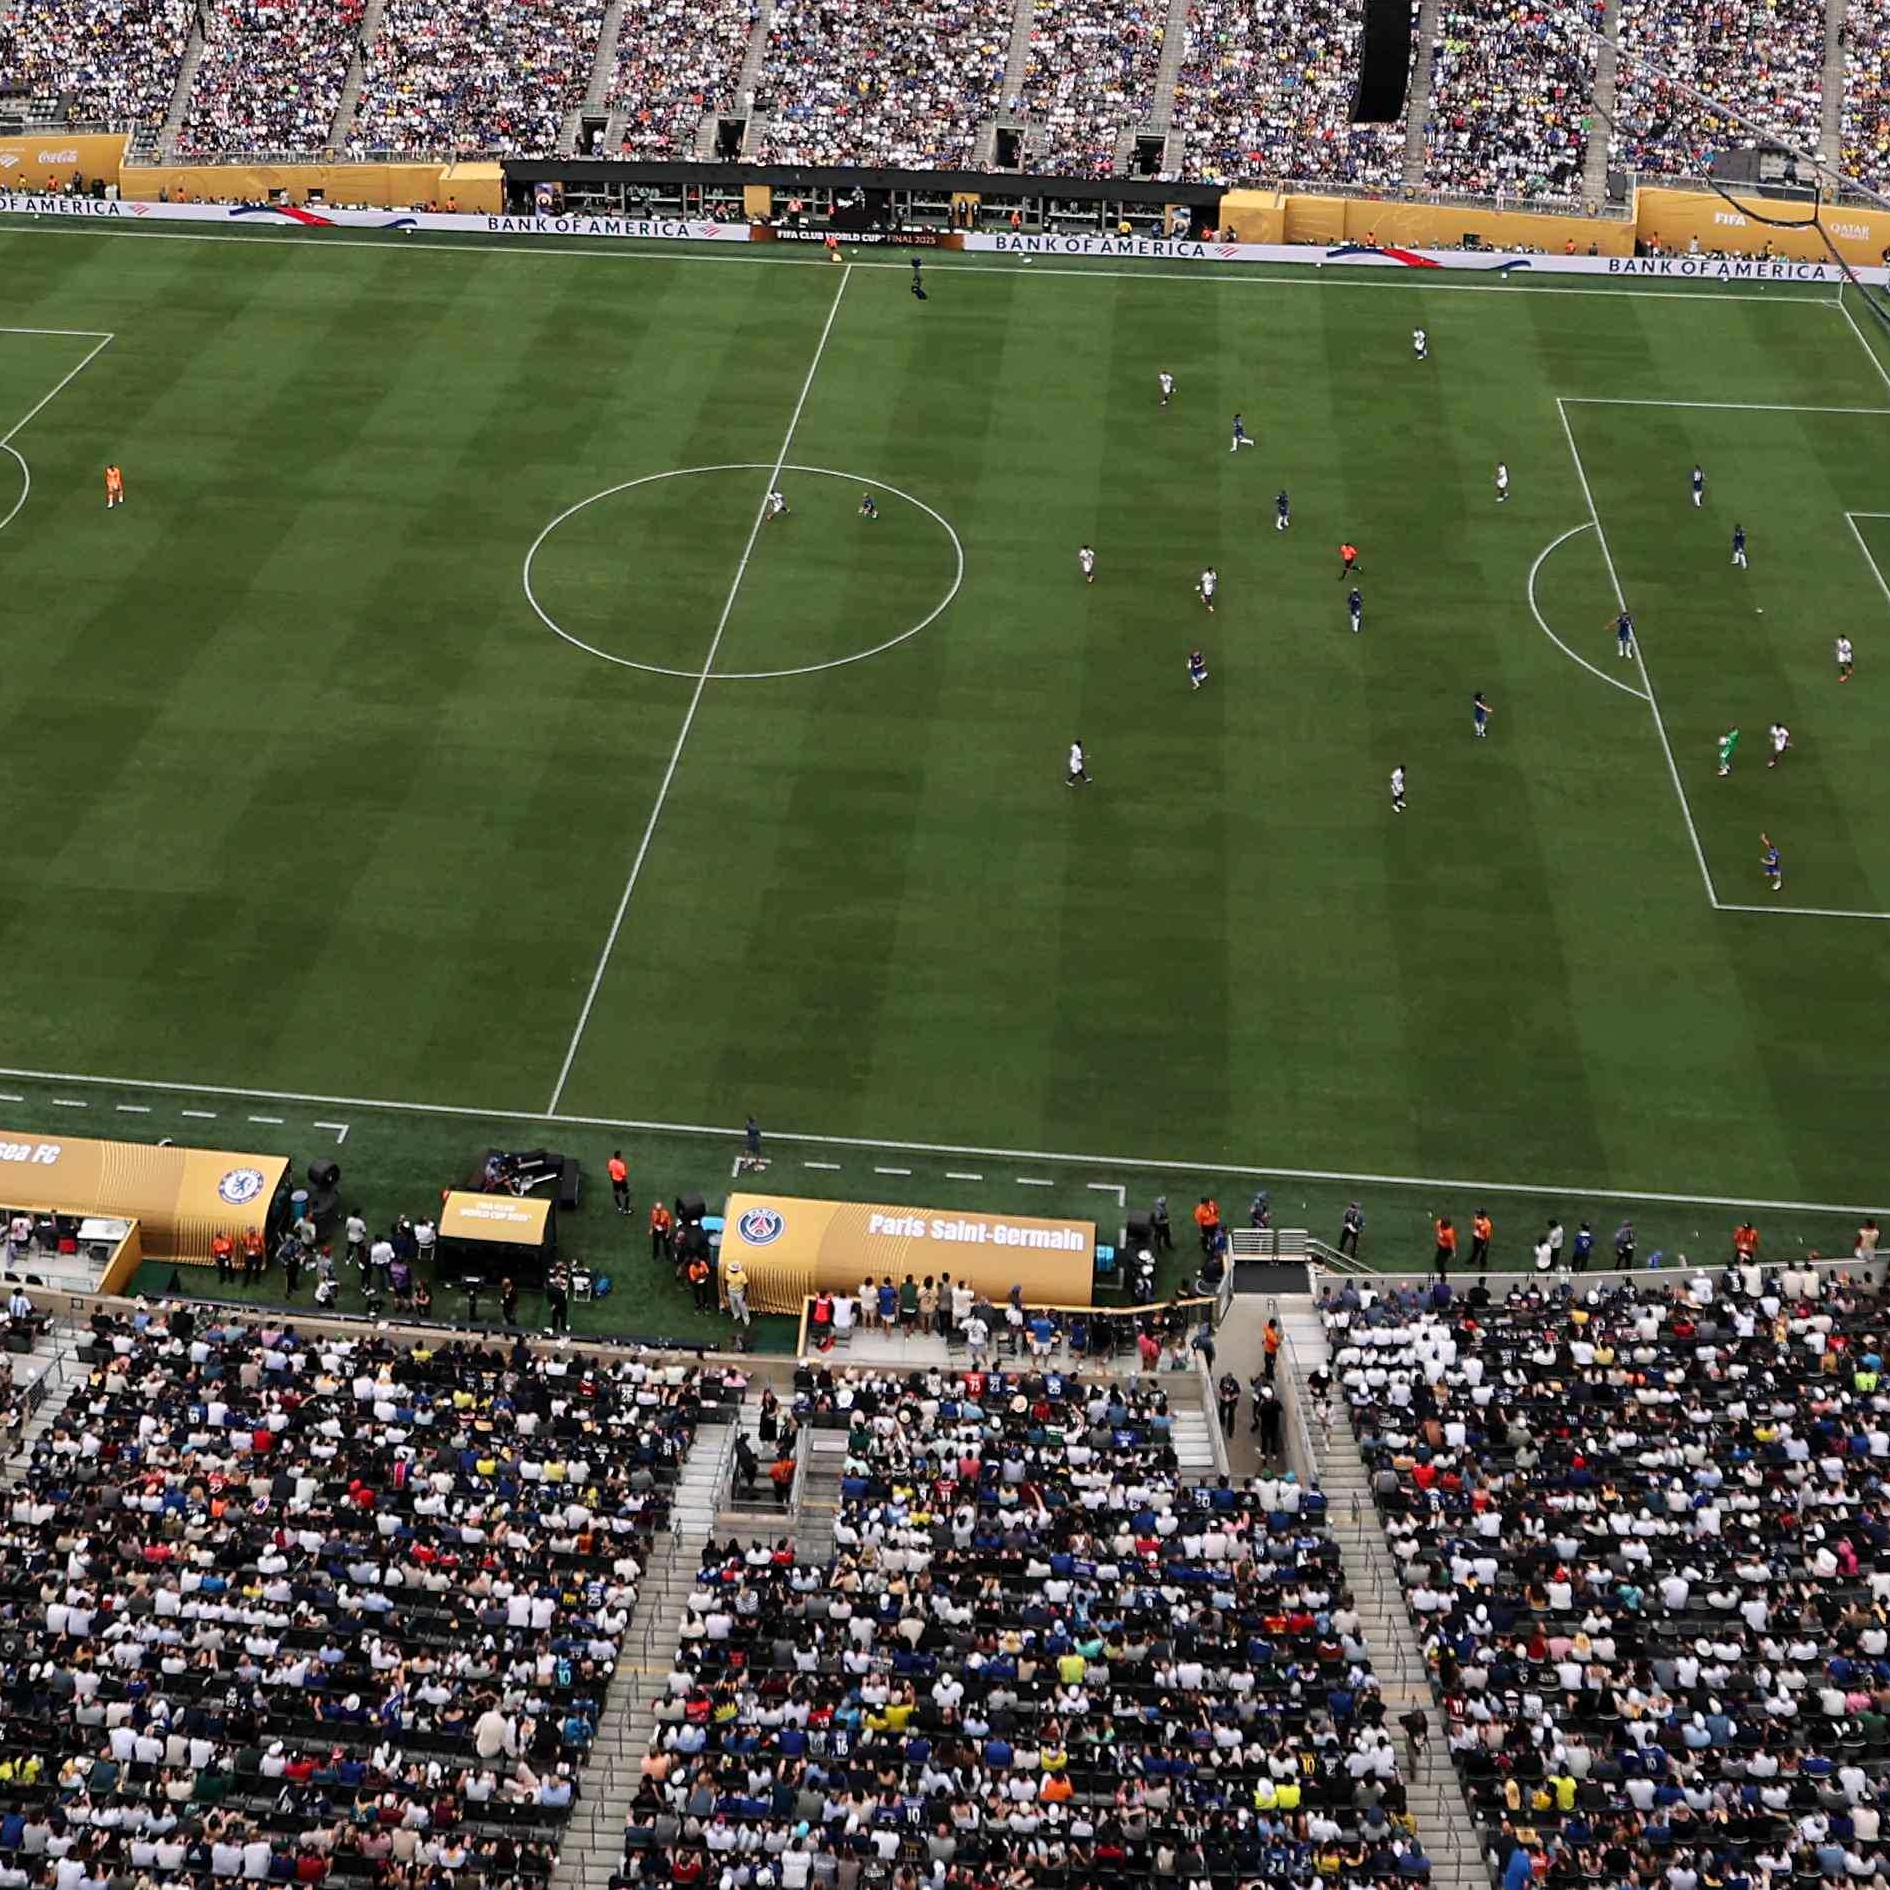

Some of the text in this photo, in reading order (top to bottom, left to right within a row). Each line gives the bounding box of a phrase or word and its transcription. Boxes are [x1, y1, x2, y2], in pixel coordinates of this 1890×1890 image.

[26, 198, 120, 216] AMERICA
[488, 216, 689, 237] BANK OF AMERICA
[1715, 213, 1747, 227] FIFA
[776, 230, 798, 239] FIFA
[799, 231, 824, 240] CLUB
[824, 232, 860, 241] WORLD
[886, 234, 912, 243] FINAL
[996, 235, 1206, 258] BANK OF AMERICA
[1609, 258, 1827, 280] BANK OF AMERICA
[31, 1143, 62, 1165] FC
[869, 1213, 1084, 1252] Paris Saint-Germain
[557, 1670, 571, 1685] 10
[1302, 1756, 1315, 1770] 10
[907, 1807, 921, 1824] 10
